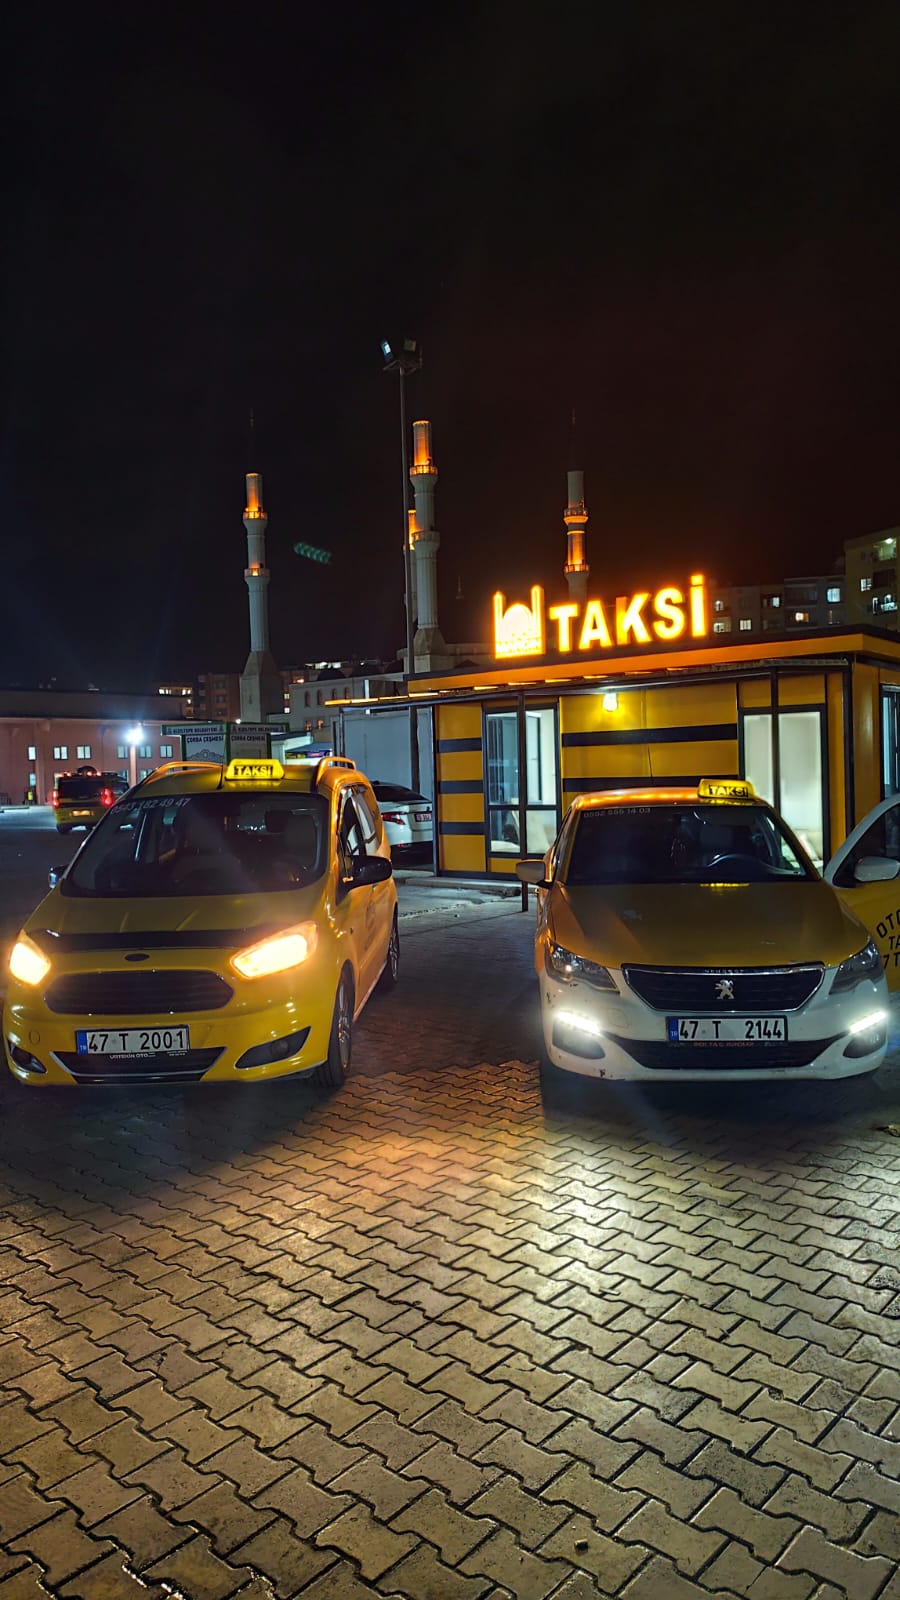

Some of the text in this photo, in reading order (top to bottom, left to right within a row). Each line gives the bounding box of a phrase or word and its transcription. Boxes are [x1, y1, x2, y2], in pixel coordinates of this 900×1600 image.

[549, 574, 707, 652] TAKSİ
[680, 1020, 699, 1039] 47
[711, 1020, 722, 1039] T
[744, 1020, 783, 1039] 2144
[88, 1033, 109, 1052] 47
[118, 1032, 129, 1051] T
[139, 1030, 184, 1050] 2001
